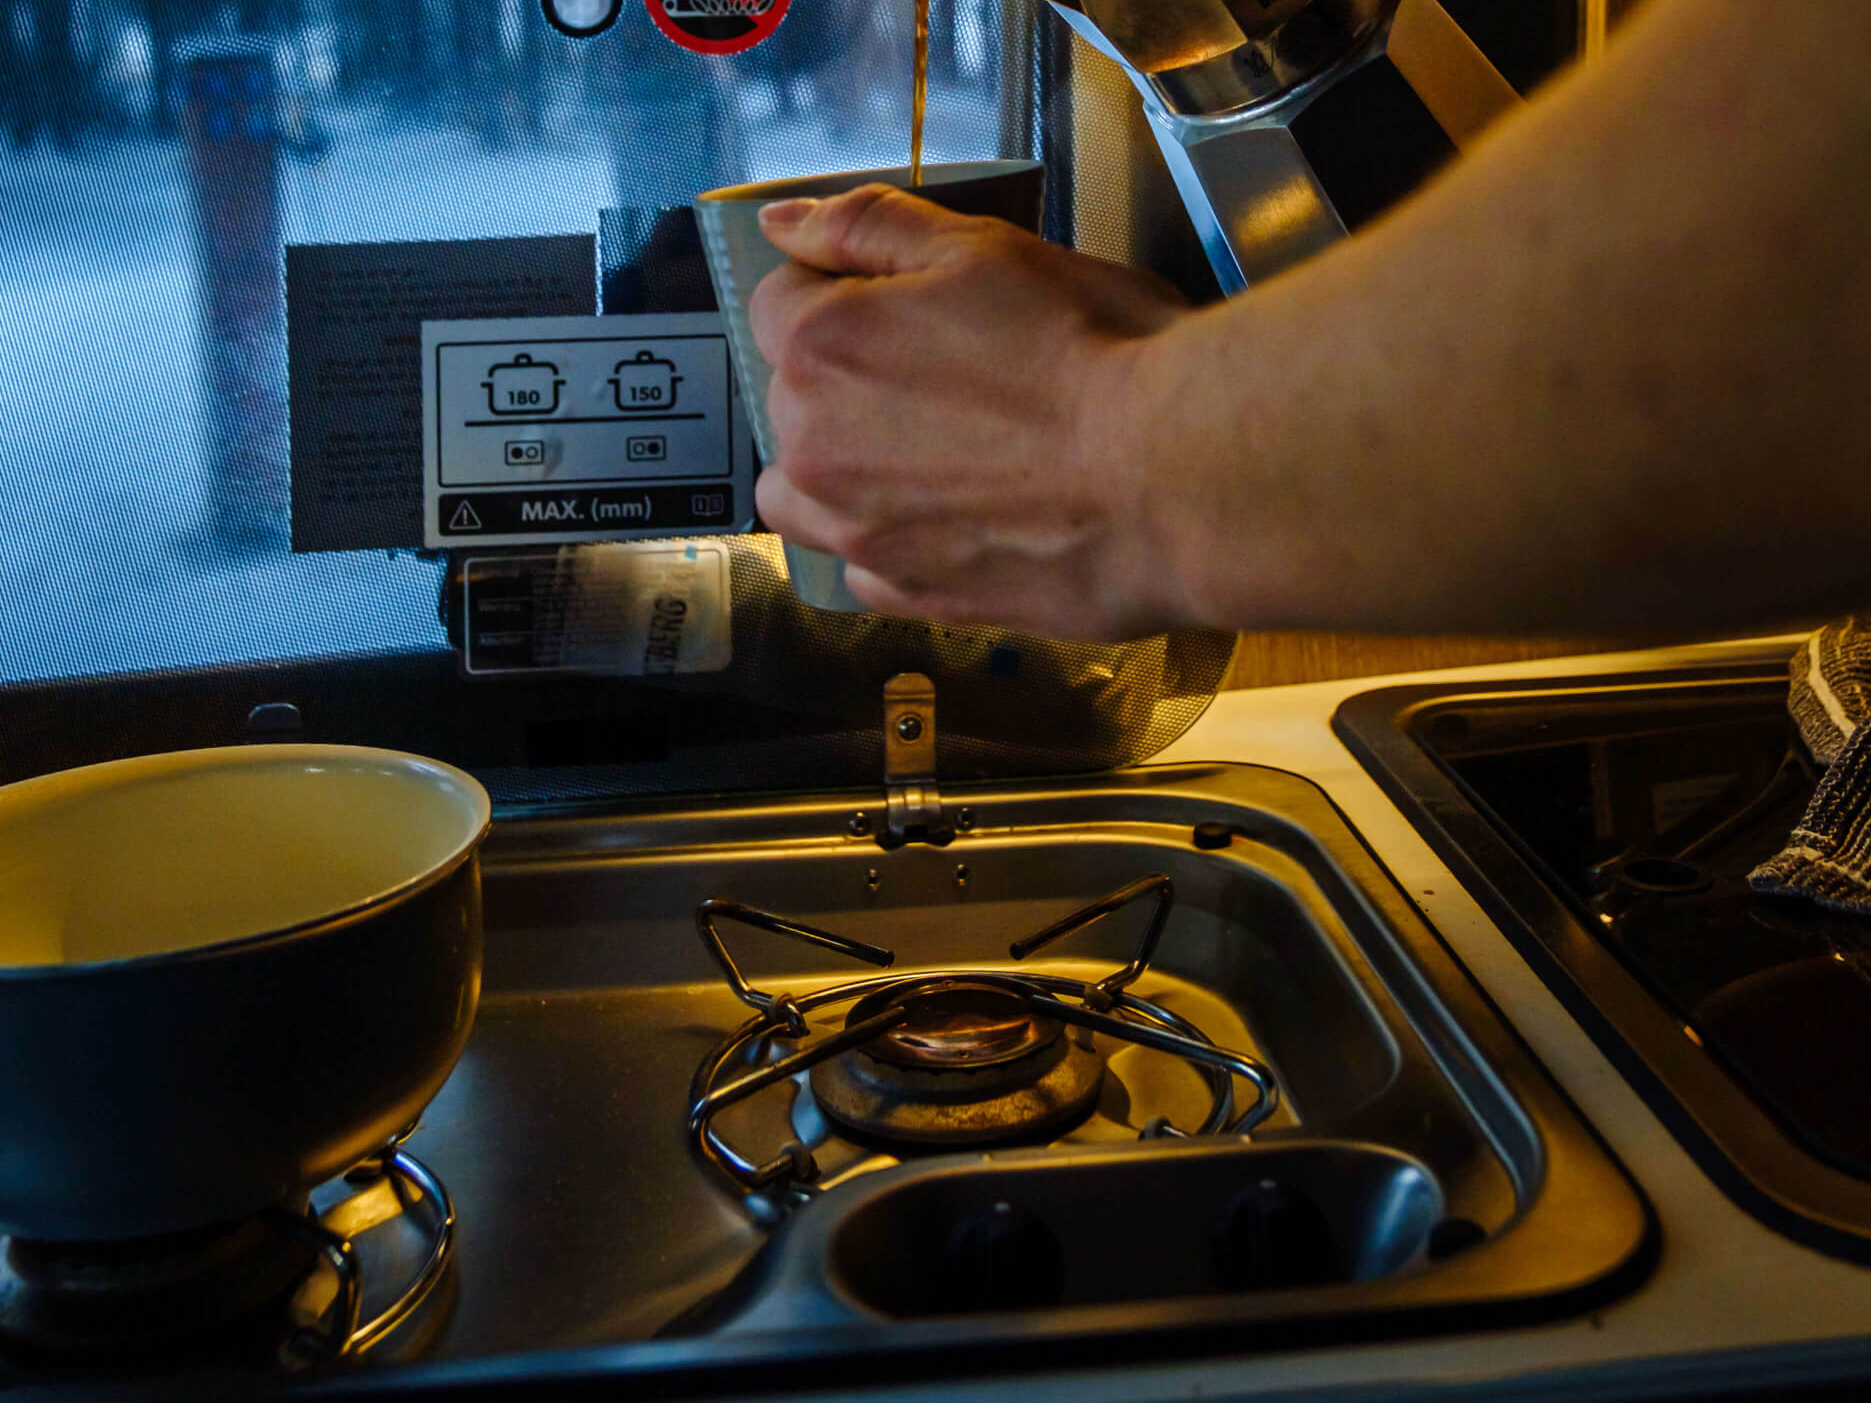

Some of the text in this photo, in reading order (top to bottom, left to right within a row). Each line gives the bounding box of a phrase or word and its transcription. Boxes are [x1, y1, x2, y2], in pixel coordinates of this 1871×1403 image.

[508, 390, 541, 405] 180
[630, 386, 662, 401] 150
[521, 494, 653, 523] MAX. (mm)
